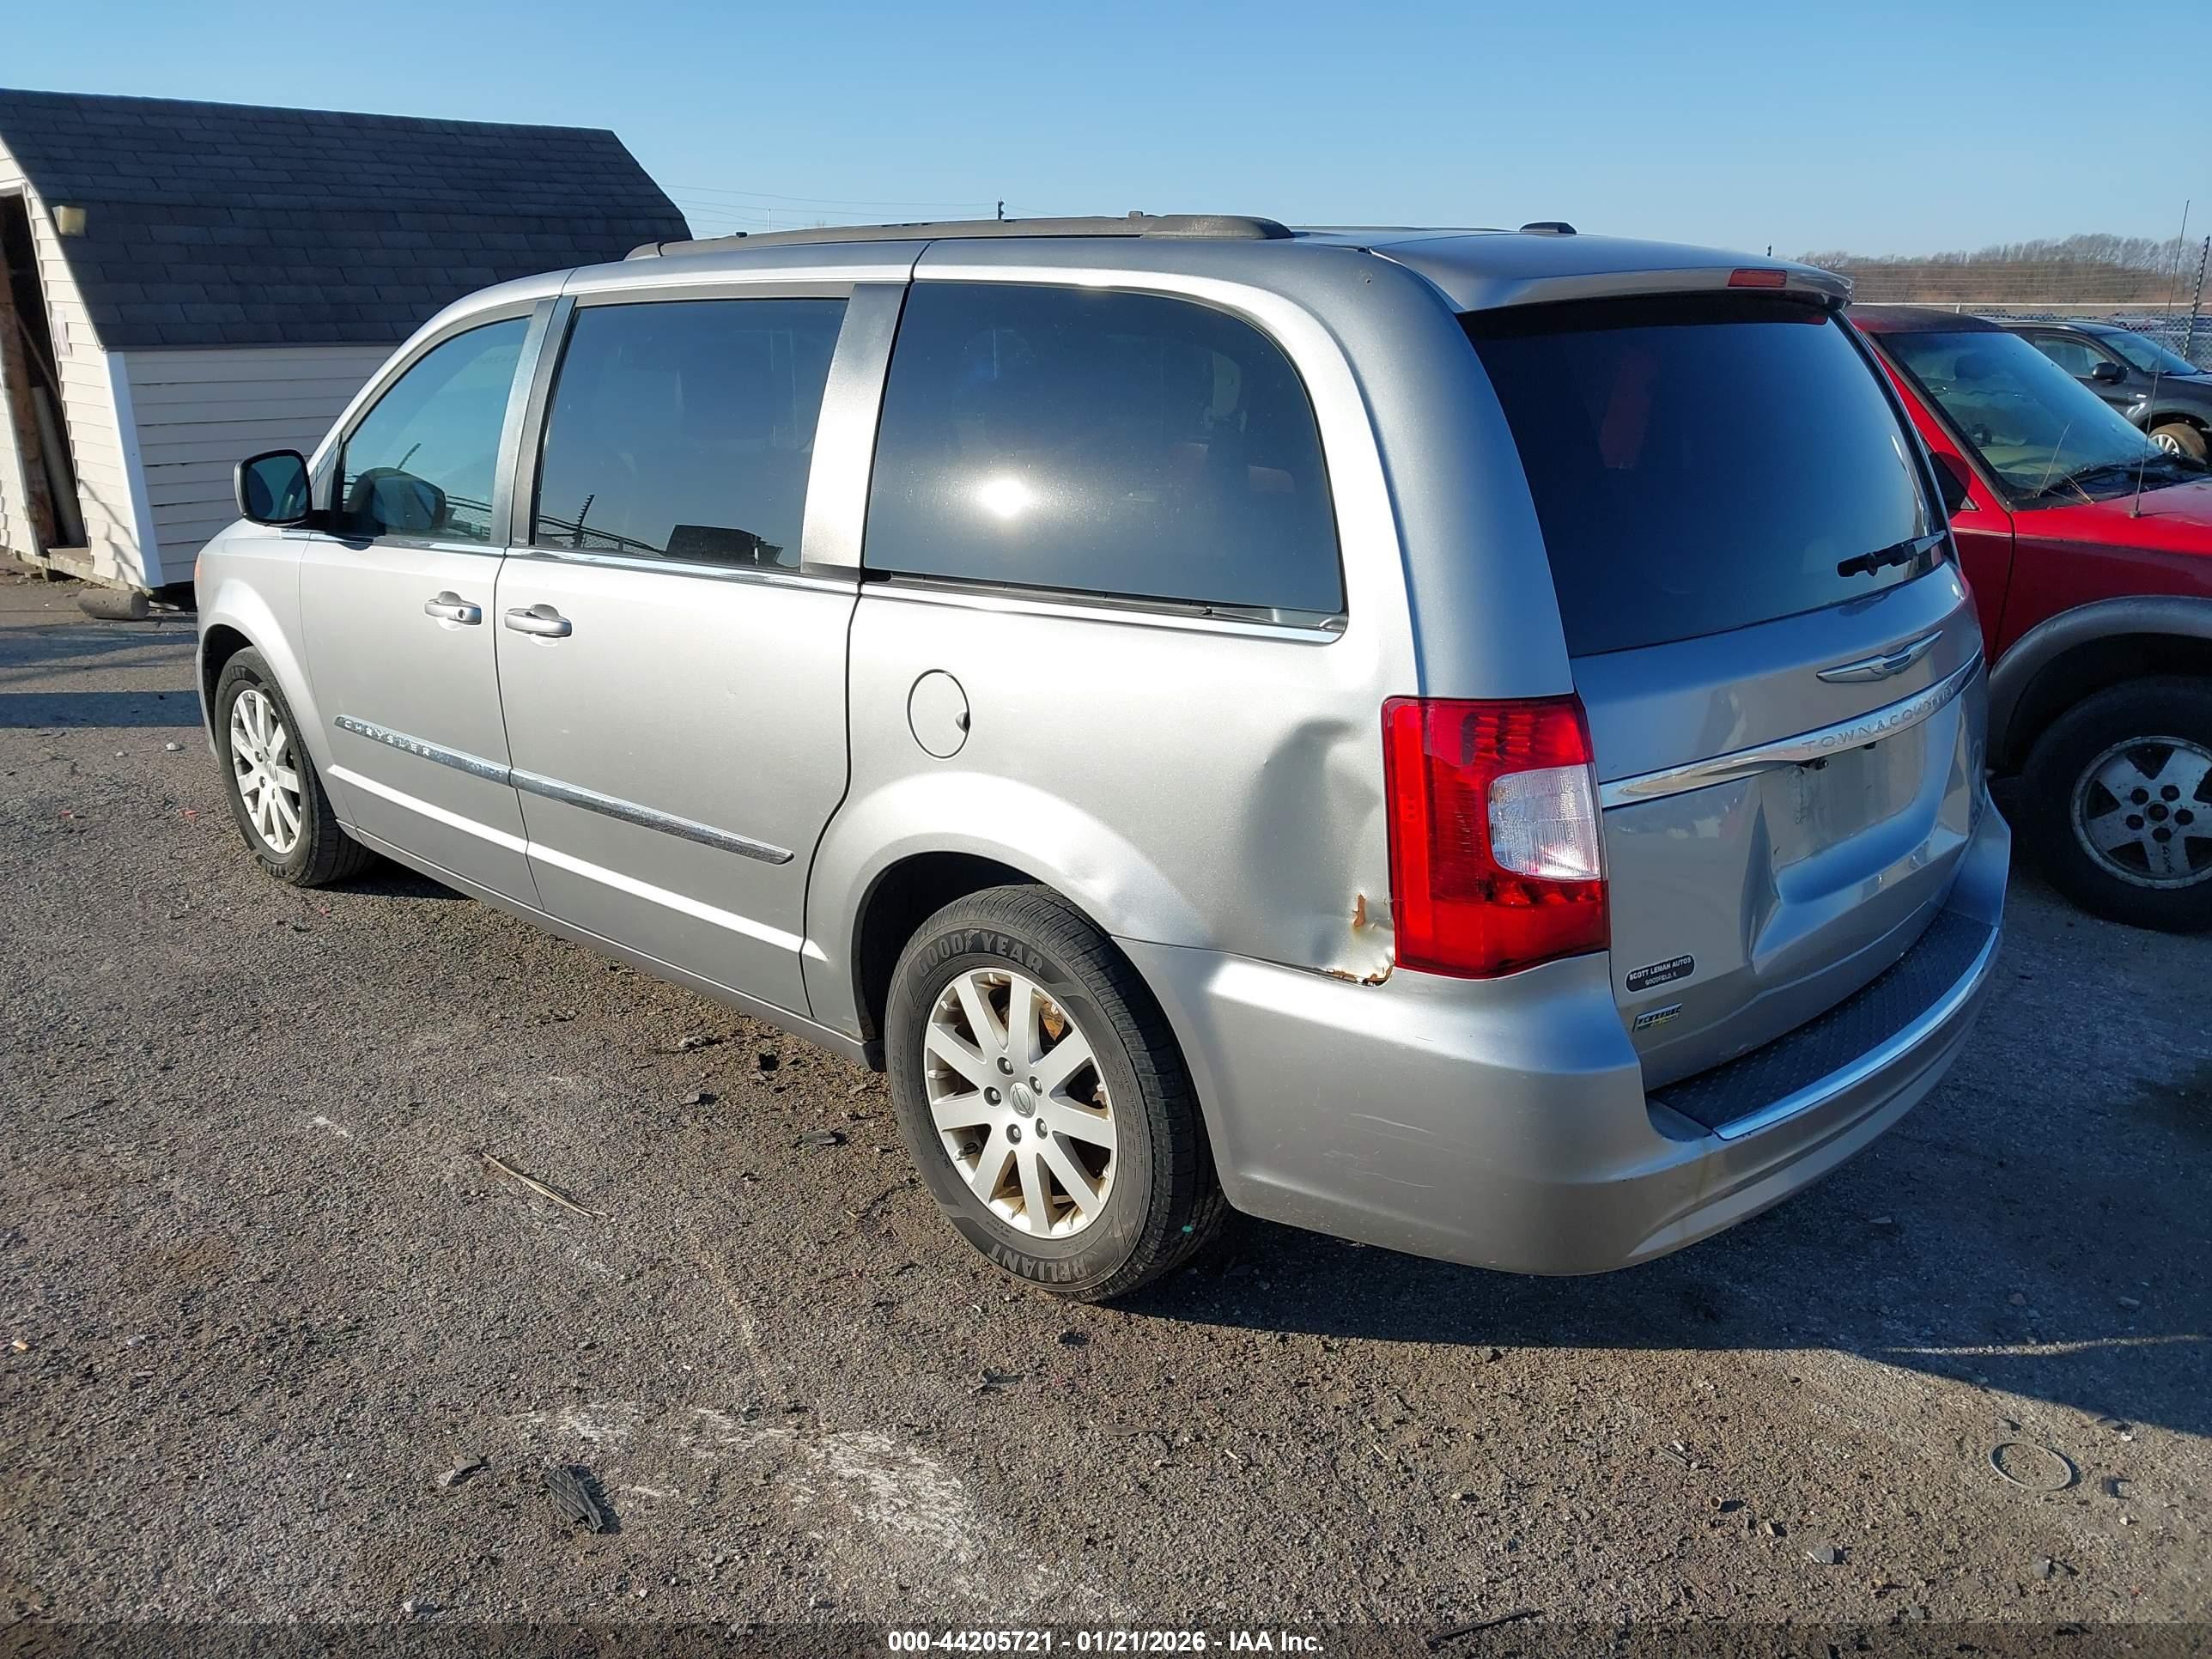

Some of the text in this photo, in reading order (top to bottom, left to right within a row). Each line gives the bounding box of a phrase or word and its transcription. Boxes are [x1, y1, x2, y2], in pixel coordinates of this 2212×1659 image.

[343, 720, 430, 757] CHRYSLER
[1629, 969, 1650, 981] SCOTT
[1650, 963, 1671, 975] LEMAN
[987, 1243, 1089, 1282] RELIANT
